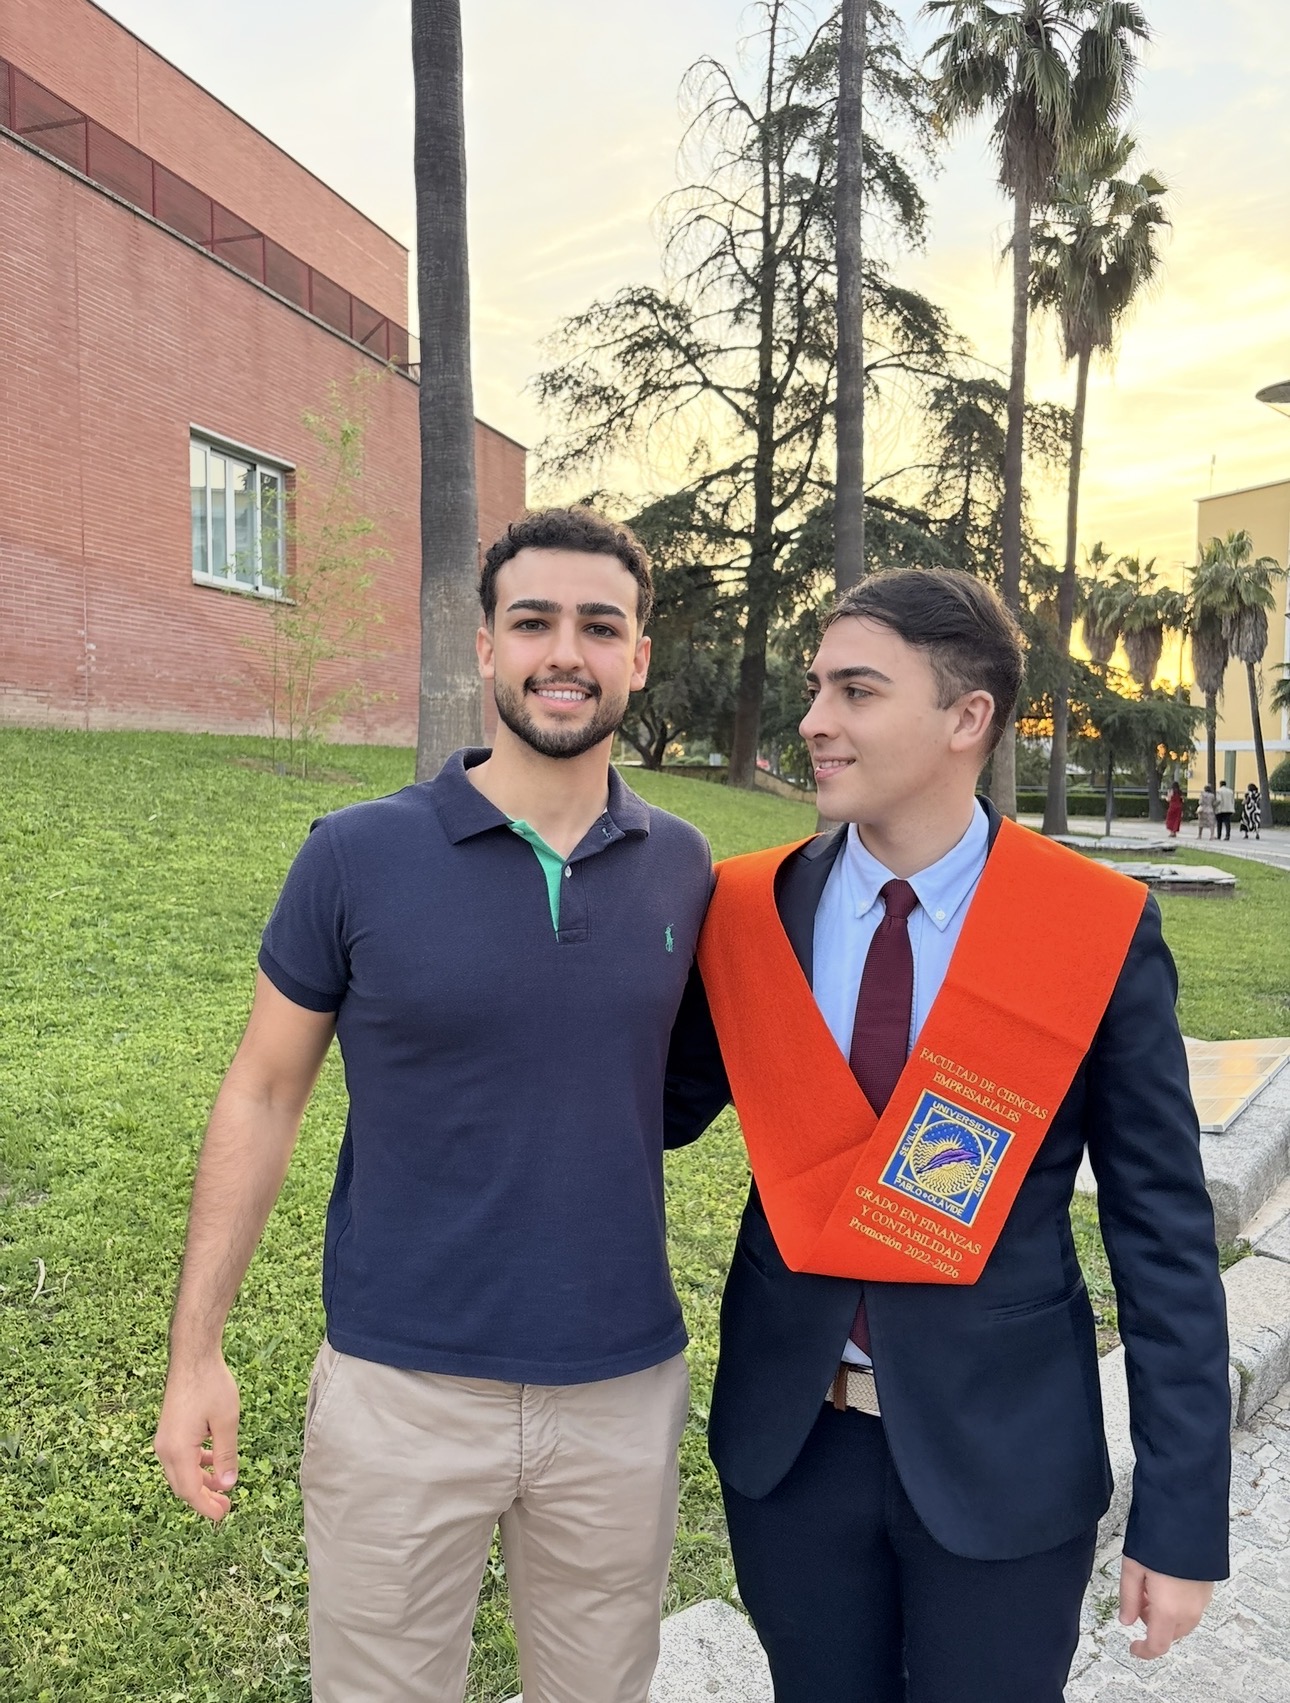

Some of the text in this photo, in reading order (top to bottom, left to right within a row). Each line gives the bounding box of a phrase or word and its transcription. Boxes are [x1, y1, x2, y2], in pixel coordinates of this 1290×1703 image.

[919, 1048, 1049, 1120] FACULTAD DE CIENCIAS
[932, 1072, 1022, 1123] EMPRESARIALES
[899, 1122, 922, 1157] SEVILLA
[932, 1100, 1000, 1139] UNIVERSIDAD
[893, 1176, 965, 1217] PABLO OLAVIDE
[973, 1178, 987, 1198] 1997
[855, 1185, 982, 1255] GRADO EN FINANZAS
[860, 1205, 963, 1263] Y CONTABILIDAD
[848, 1217, 960, 1279] Promoción 2022-2026
